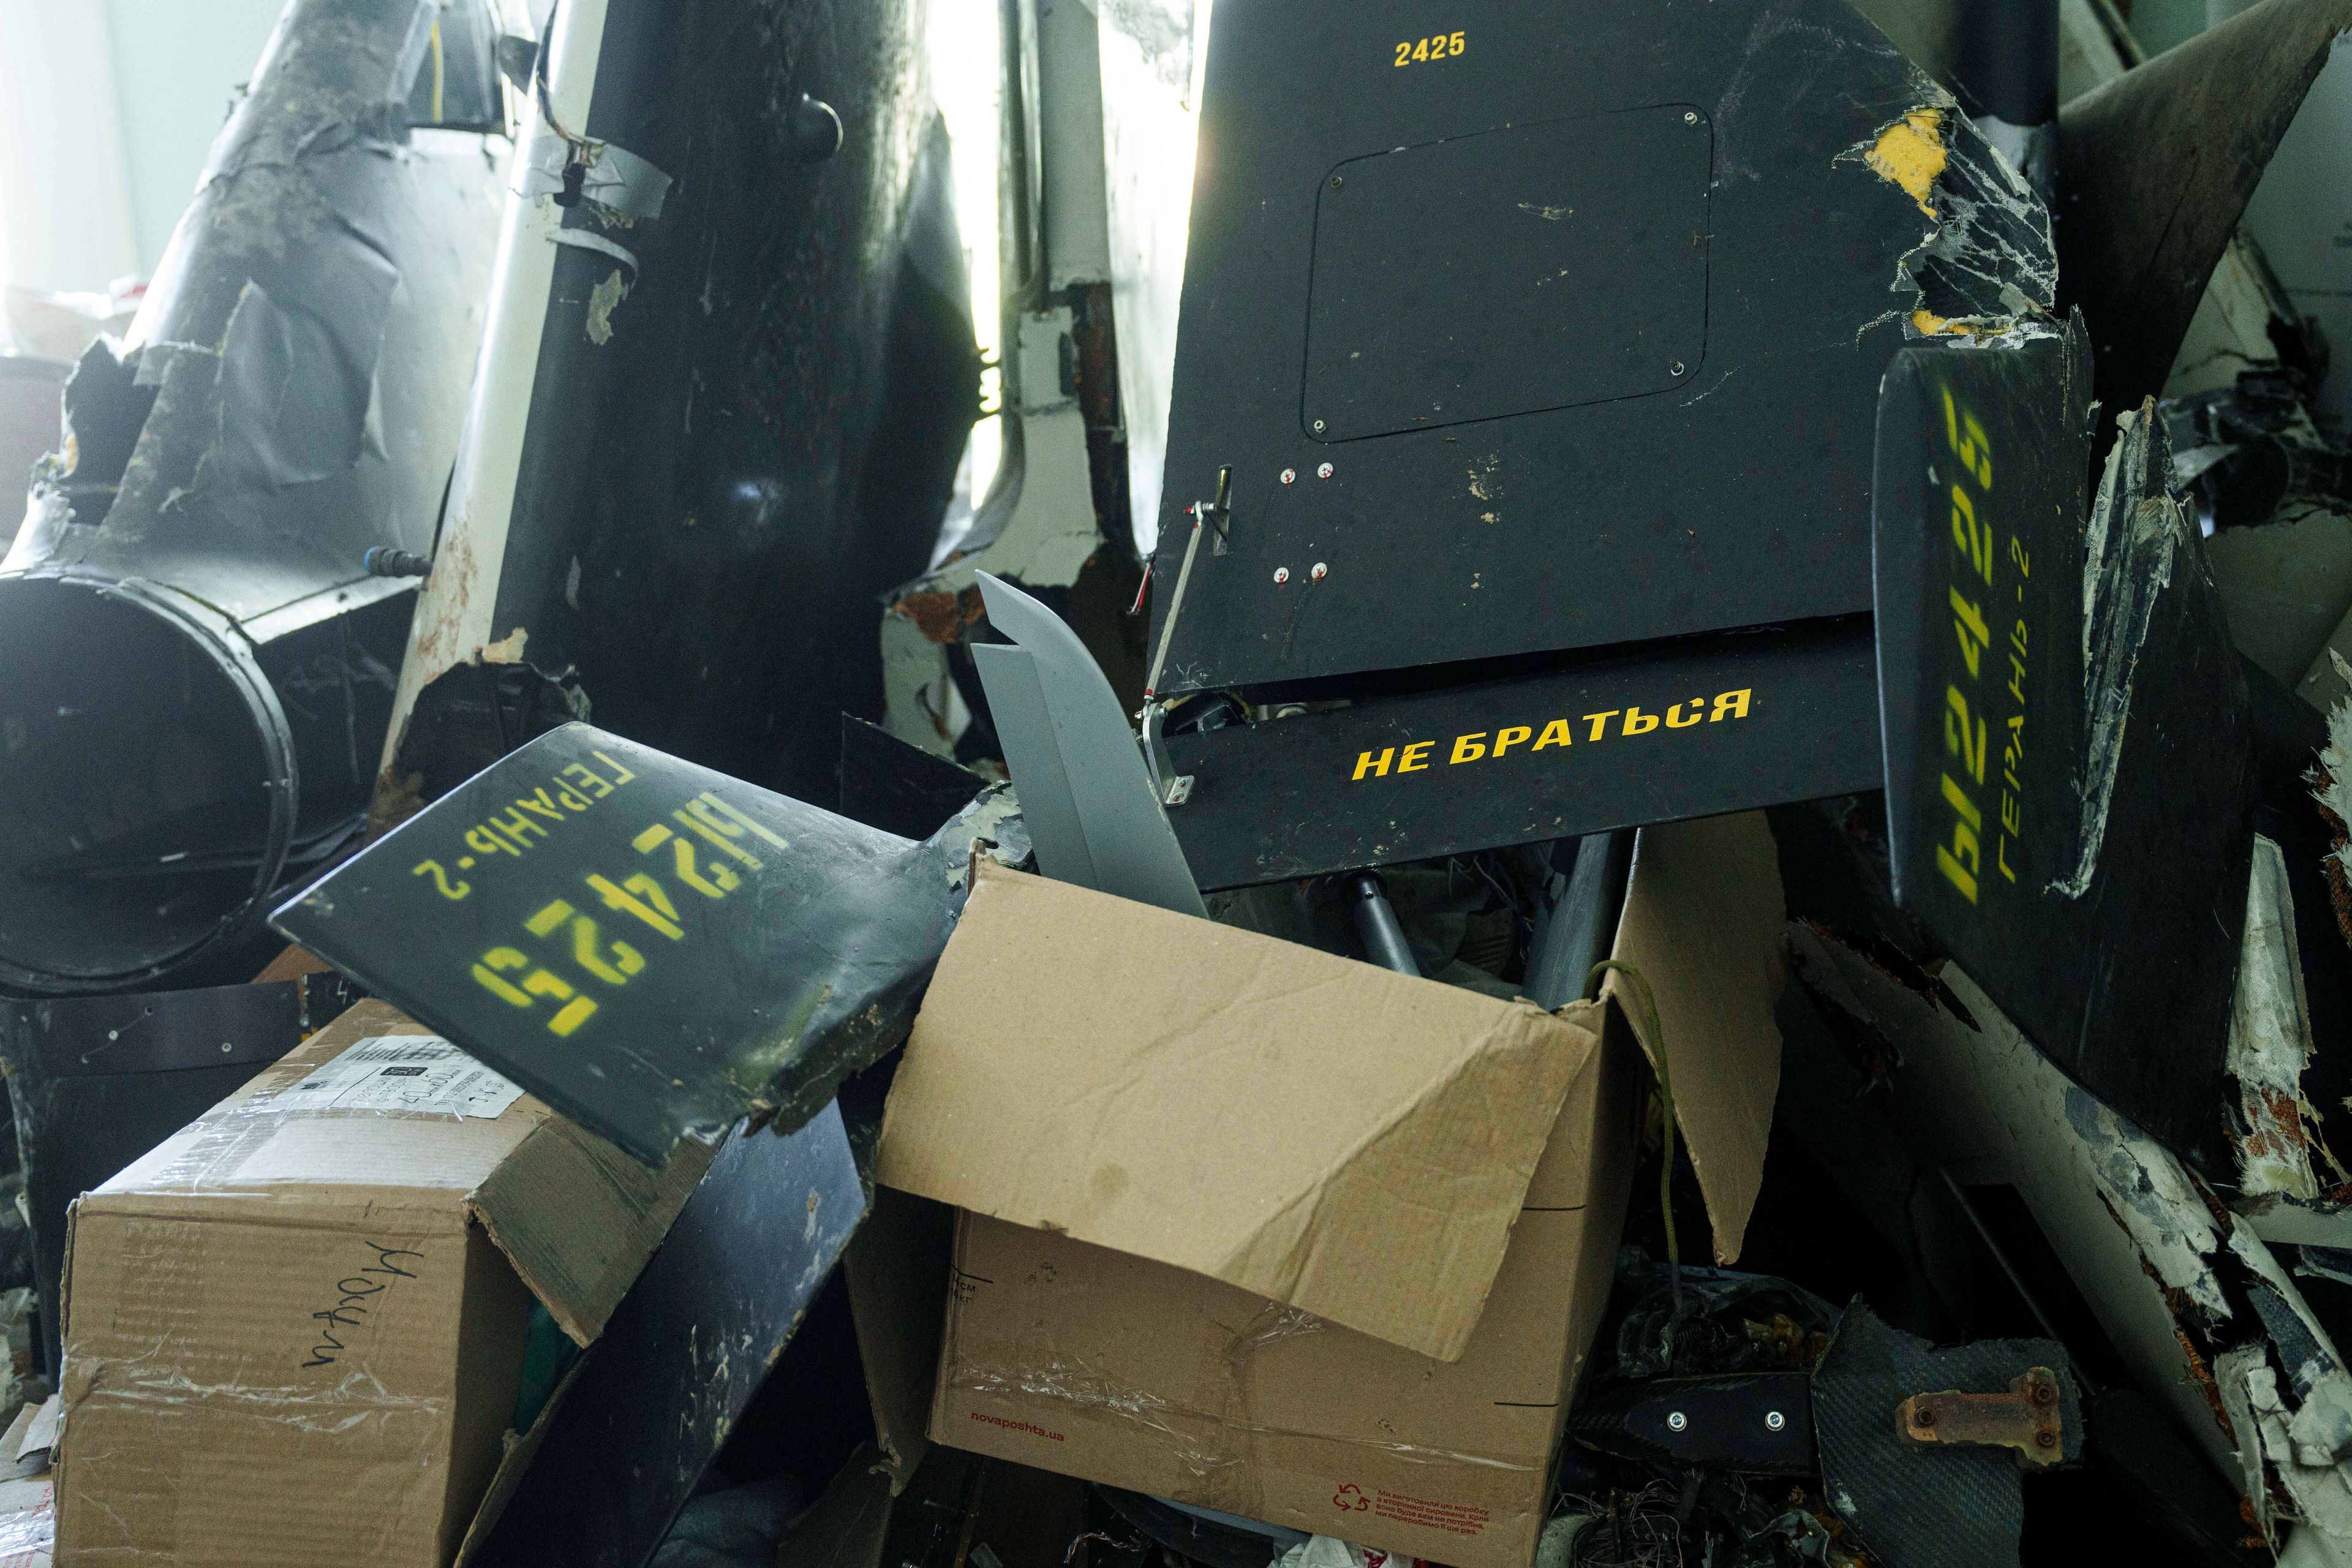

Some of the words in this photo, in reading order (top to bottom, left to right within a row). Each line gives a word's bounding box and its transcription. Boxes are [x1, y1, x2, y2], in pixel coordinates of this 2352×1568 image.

[1394, 31, 1466, 67] 2425
[1351, 740, 1436, 781] НЕ
[1449, 688, 1752, 765] БРАТЬСЯ
[971, 1411, 1065, 1442] novaposhta.ua
[1378, 1489, 1391, 1498] Ми
[1392, 1492, 1439, 1507] виготовили
[1455, 1505, 1489, 1516] коробку
[1383, 1498, 1424, 1512] вторинної
[1469, 1513, 1489, 1523] Коли
[1388, 1513, 1439, 1529] переробимо
